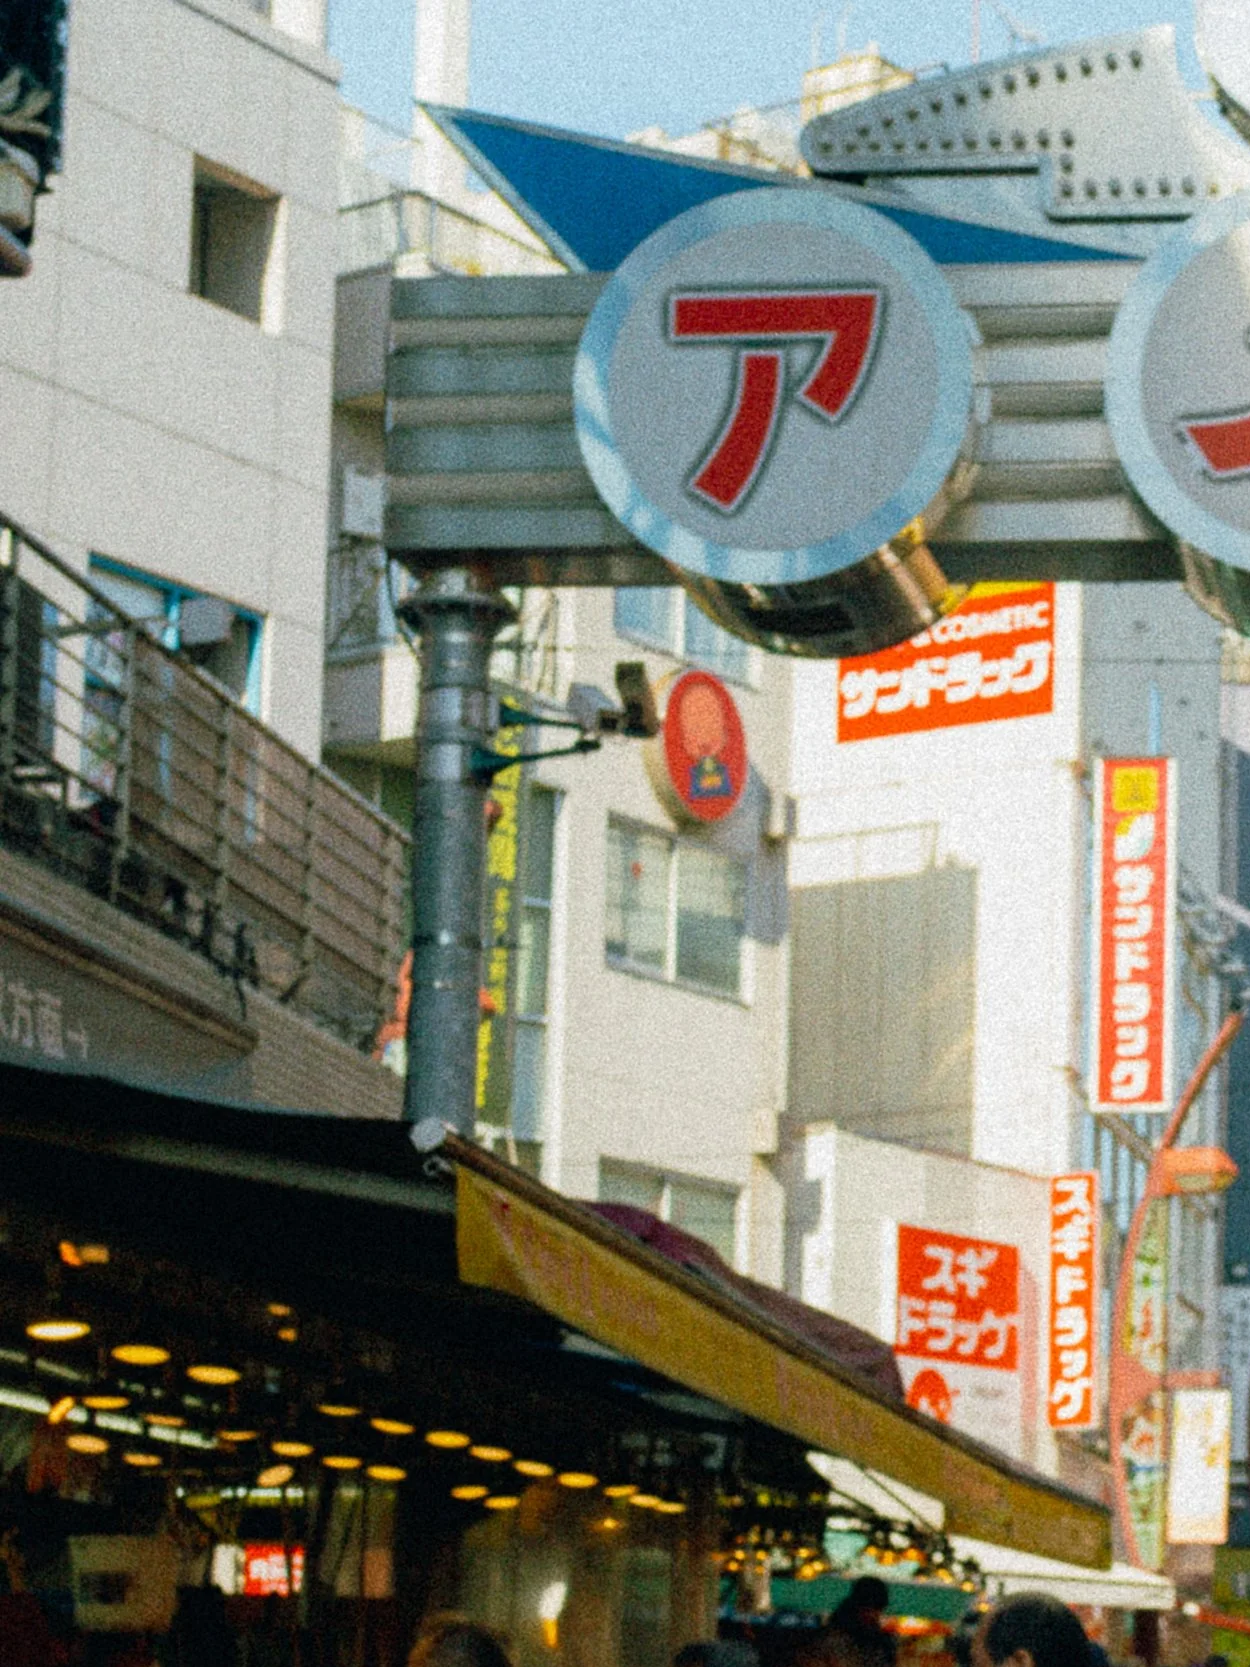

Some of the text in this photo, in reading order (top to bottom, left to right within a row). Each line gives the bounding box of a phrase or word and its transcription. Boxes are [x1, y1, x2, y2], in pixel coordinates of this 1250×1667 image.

[931, 601, 1050, 645] COSMETIC
[841, 640, 1052, 718] サンドラッグ
[1111, 864, 1155, 1100] サンドラッグ
[921, 1244, 999, 1297] スギ
[1052, 1179, 1092, 1420] スギドラッグ
[898, 1296, 1024, 1360] ドラッグ
